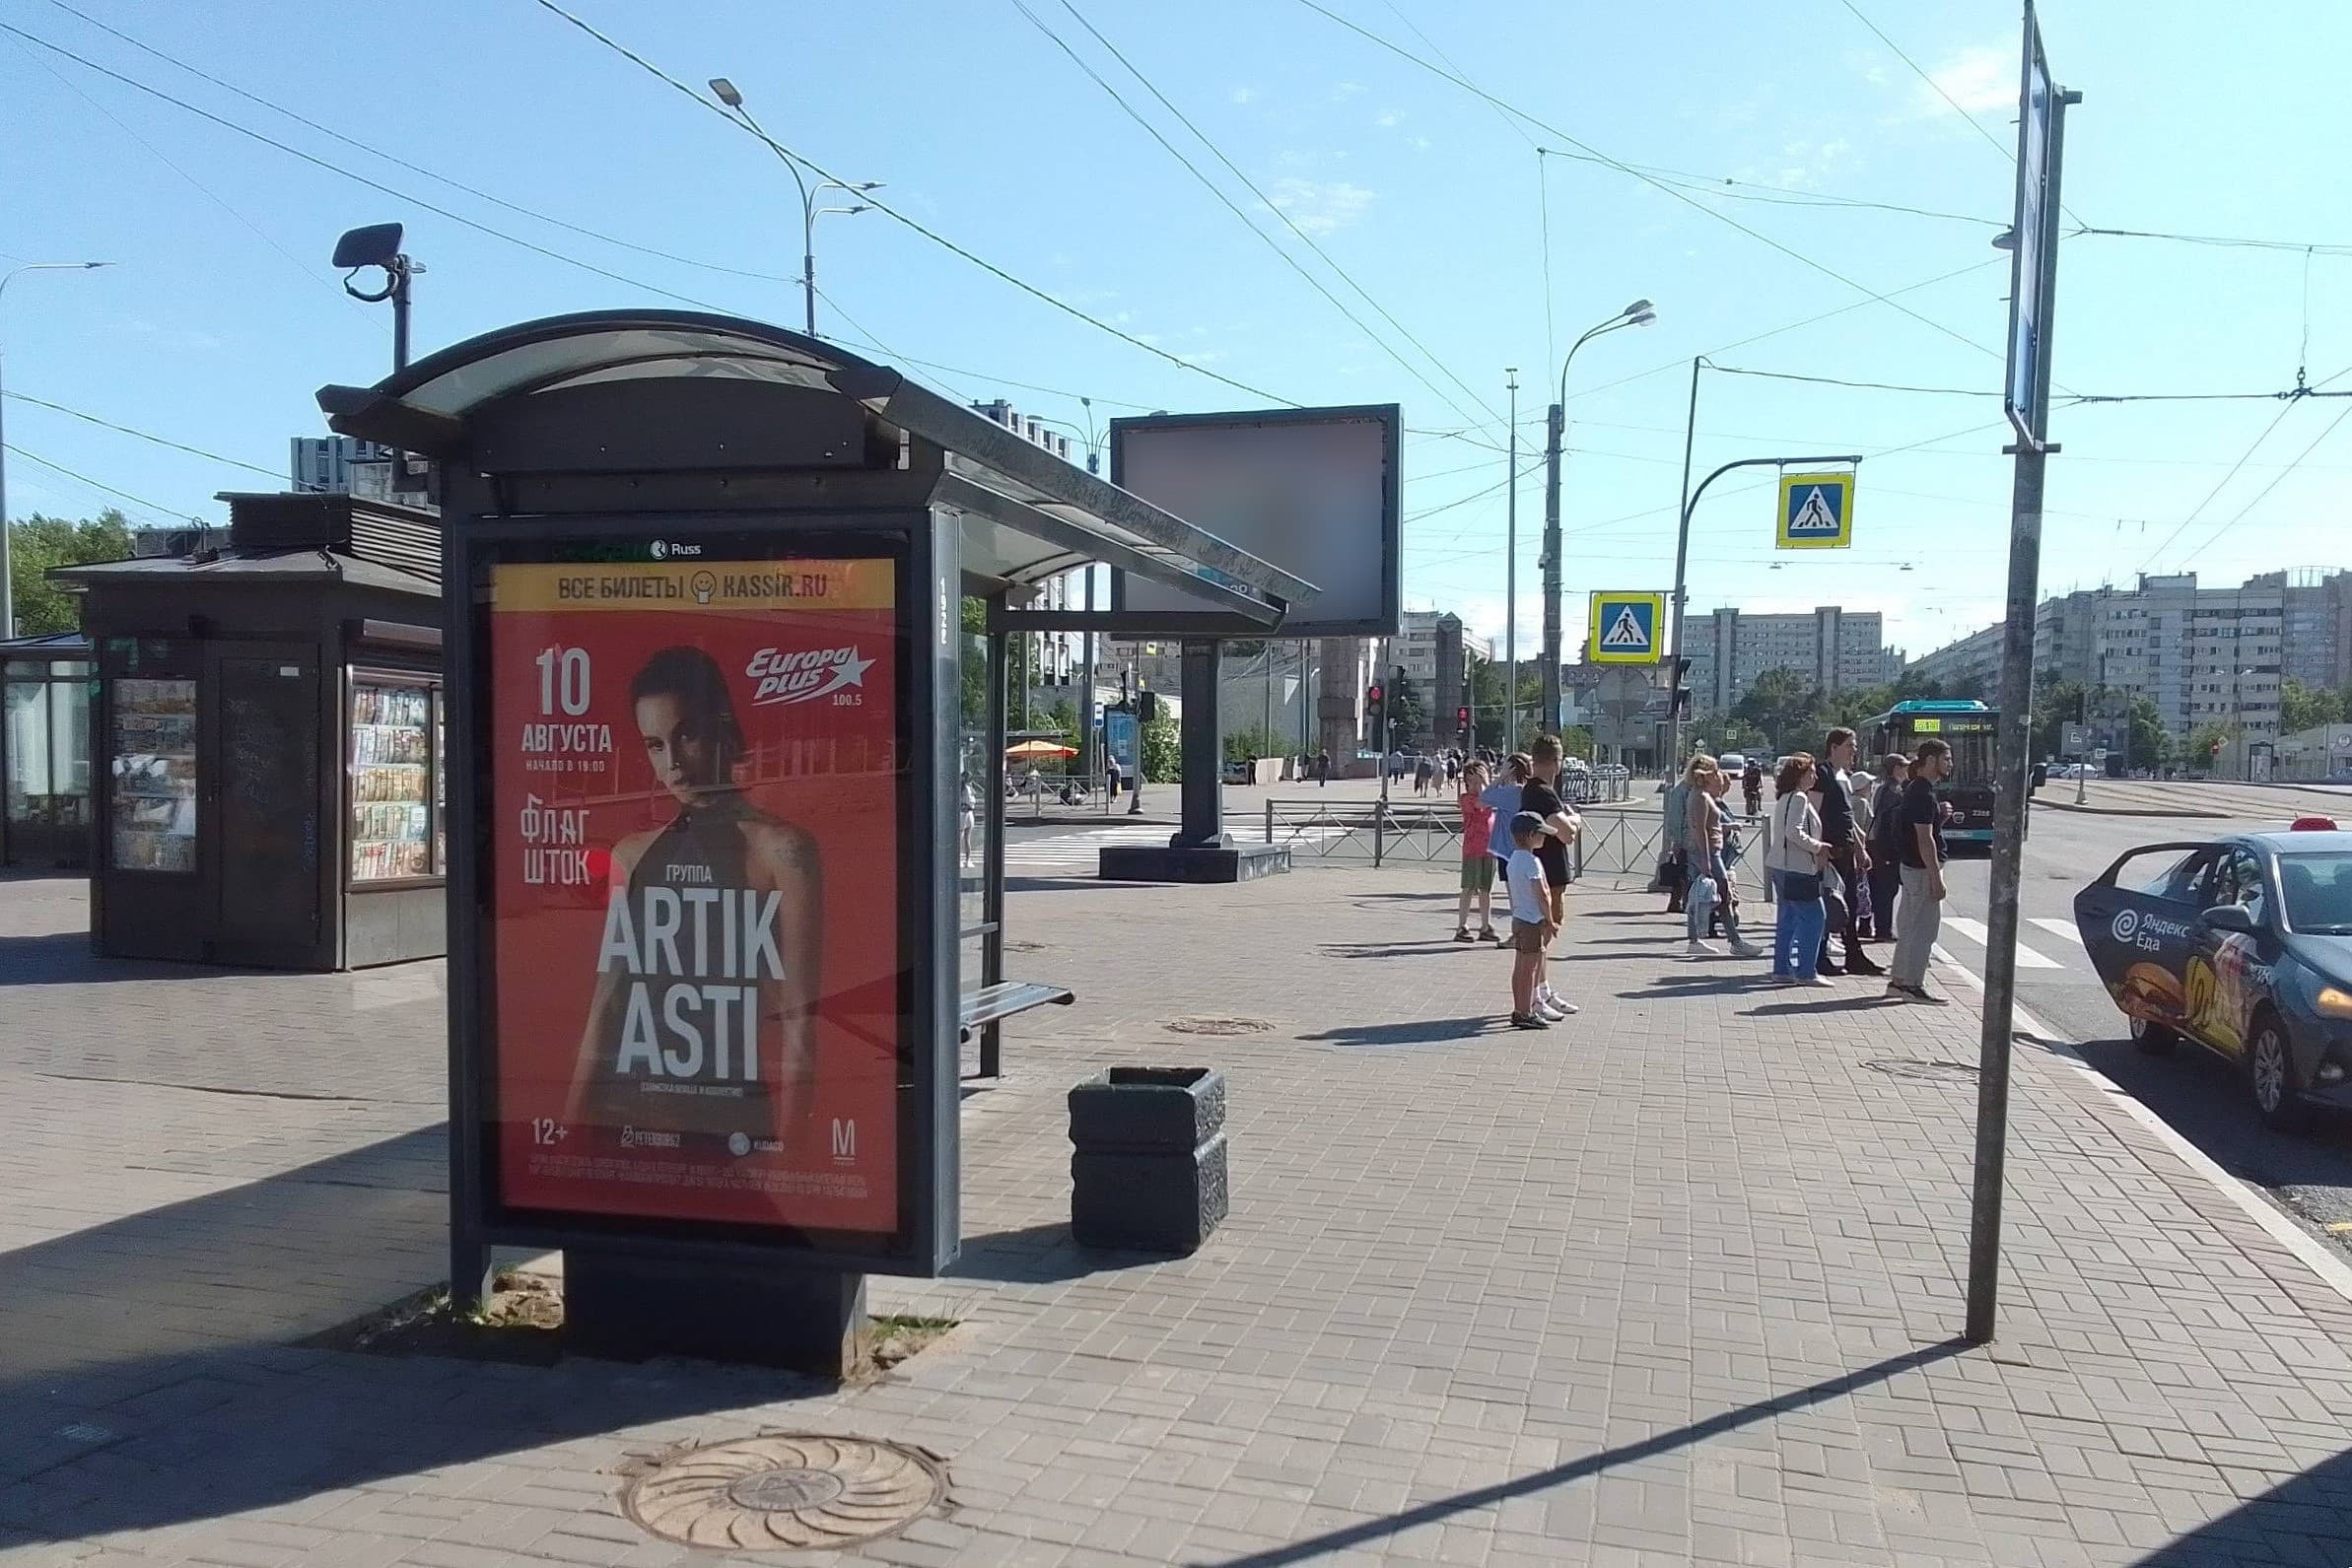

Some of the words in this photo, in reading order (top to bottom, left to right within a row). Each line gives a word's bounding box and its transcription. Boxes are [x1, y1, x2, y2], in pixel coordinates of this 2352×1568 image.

[671, 543, 702, 556] Russ
[558, 577, 594, 600] ВСЕ
[600, 576, 684, 599] БИЛЕТЫ
[746, 647, 853, 678] Europa
[536, 647, 590, 716] 10
[832, 693, 863, 707] 100.5
[520, 723, 613, 753] АВГУСТА
[525, 760, 564, 772] НАЧАЛО
[578, 760, 606, 773] 19:00
[520, 792, 590, 845] ФЛАГ
[524, 849, 591, 885] ШТОК
[665, 863, 713, 883] ГРУППА
[596, 886, 787, 981] ARTIK
[2140, 914, 2191, 938] Яндекс
[2136, 931, 2161, 952] Еда
[615, 982, 758, 1081] ASTI
[531, 1117, 569, 1145] 12+
